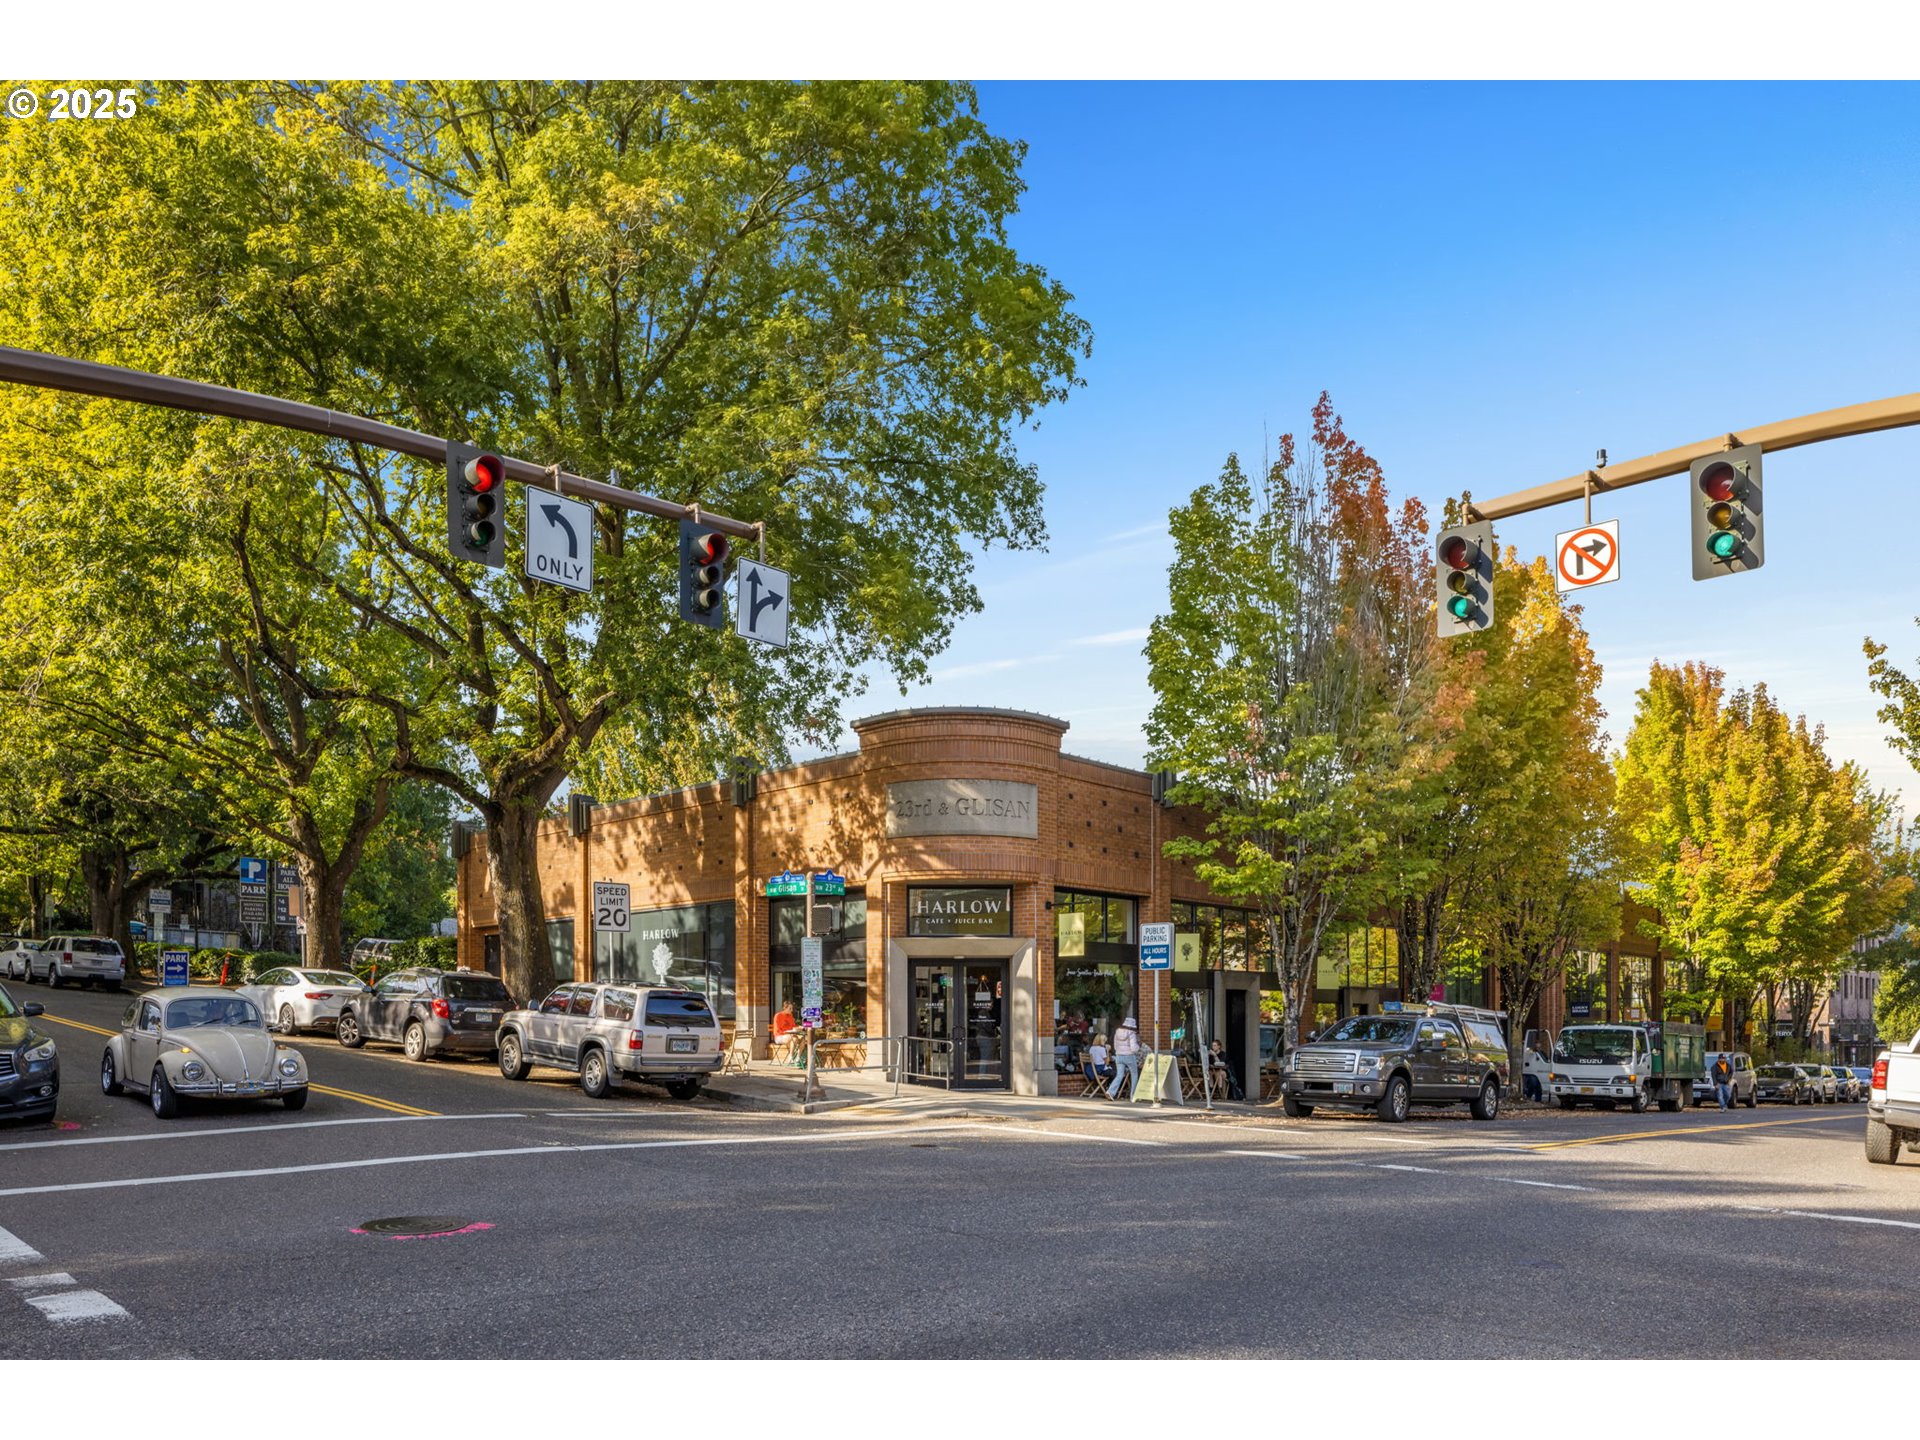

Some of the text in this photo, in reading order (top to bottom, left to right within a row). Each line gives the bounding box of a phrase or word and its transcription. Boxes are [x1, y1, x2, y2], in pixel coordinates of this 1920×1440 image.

[537, 554, 583, 580] ONLY
[896, 798, 1030, 819] 23rd & GLISAN
[241, 885, 266, 894] PARK
[597, 887, 627, 896] SPEED
[778, 884, 797, 893] Glisan
[600, 898, 624, 906] LIMIT
[917, 900, 1001, 914] HARLOW
[598, 908, 627, 927] 20
[642, 928, 680, 940] HARLOW
[166, 955, 187, 963] PARK
